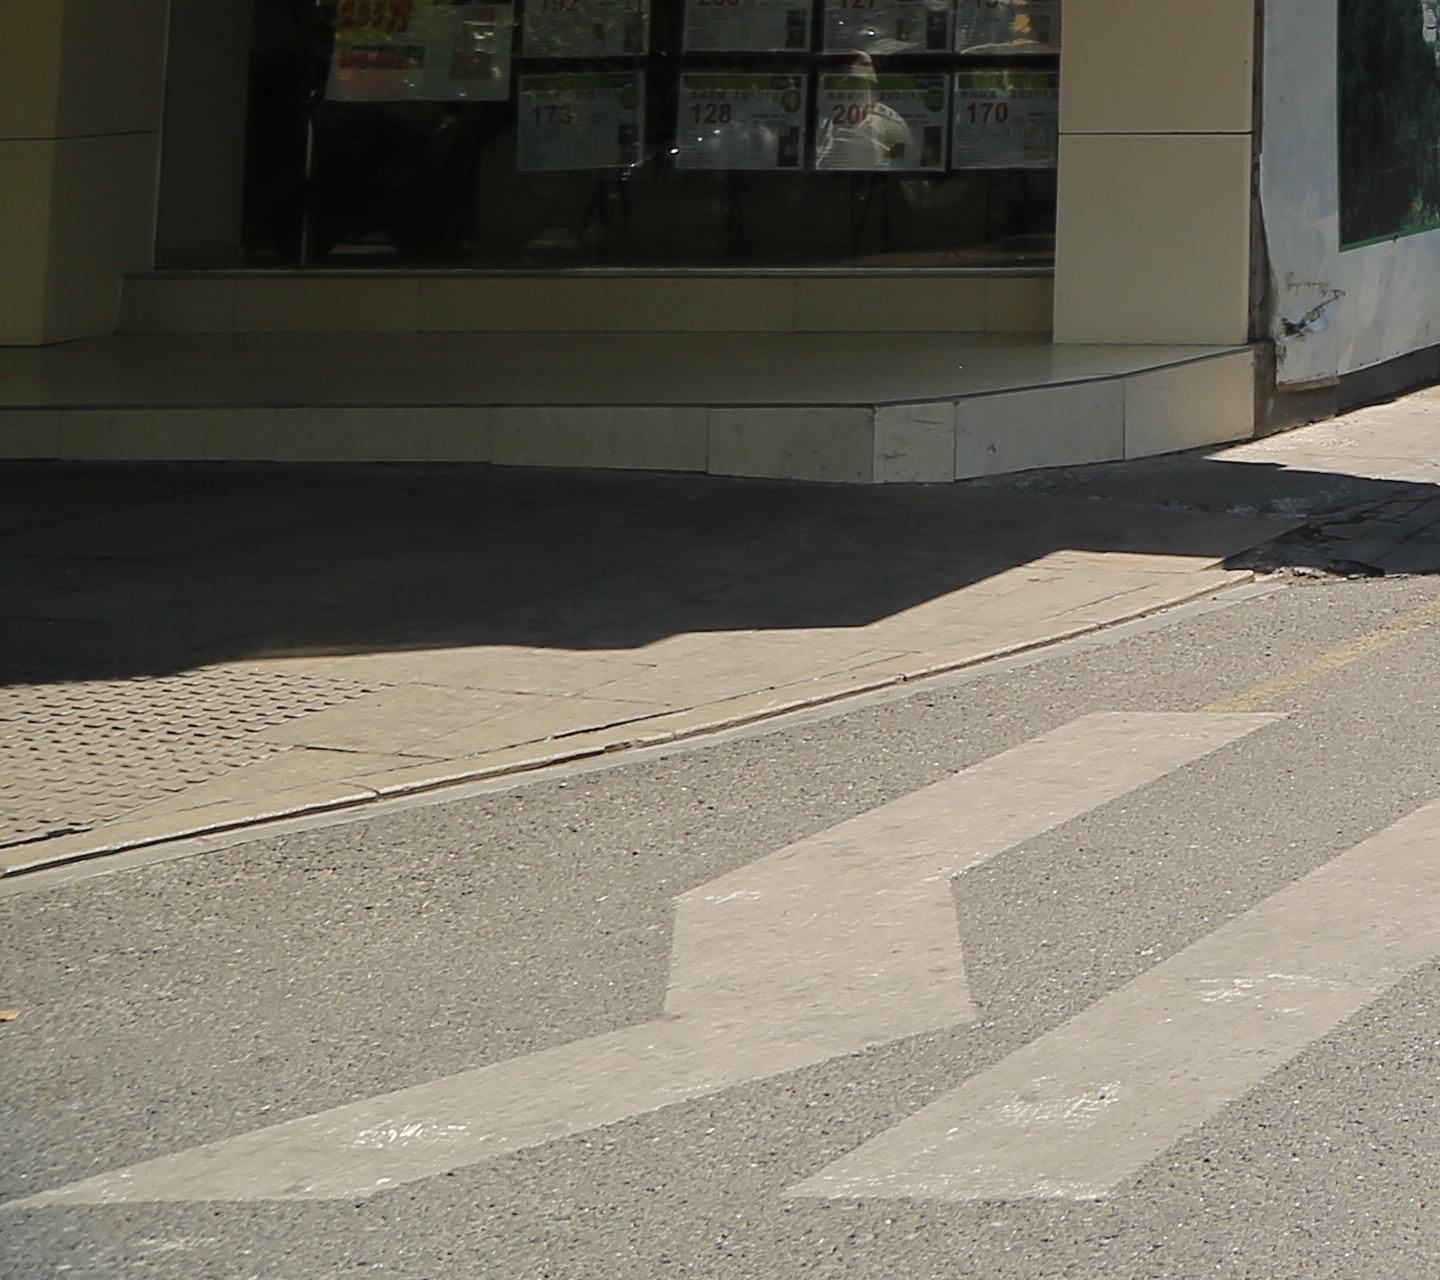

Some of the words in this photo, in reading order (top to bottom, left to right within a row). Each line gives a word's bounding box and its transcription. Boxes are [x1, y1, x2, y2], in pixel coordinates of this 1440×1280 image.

[531, 105, 573, 125] 173
[690, 103, 732, 124] 128
[966, 102, 1009, 124] 170
